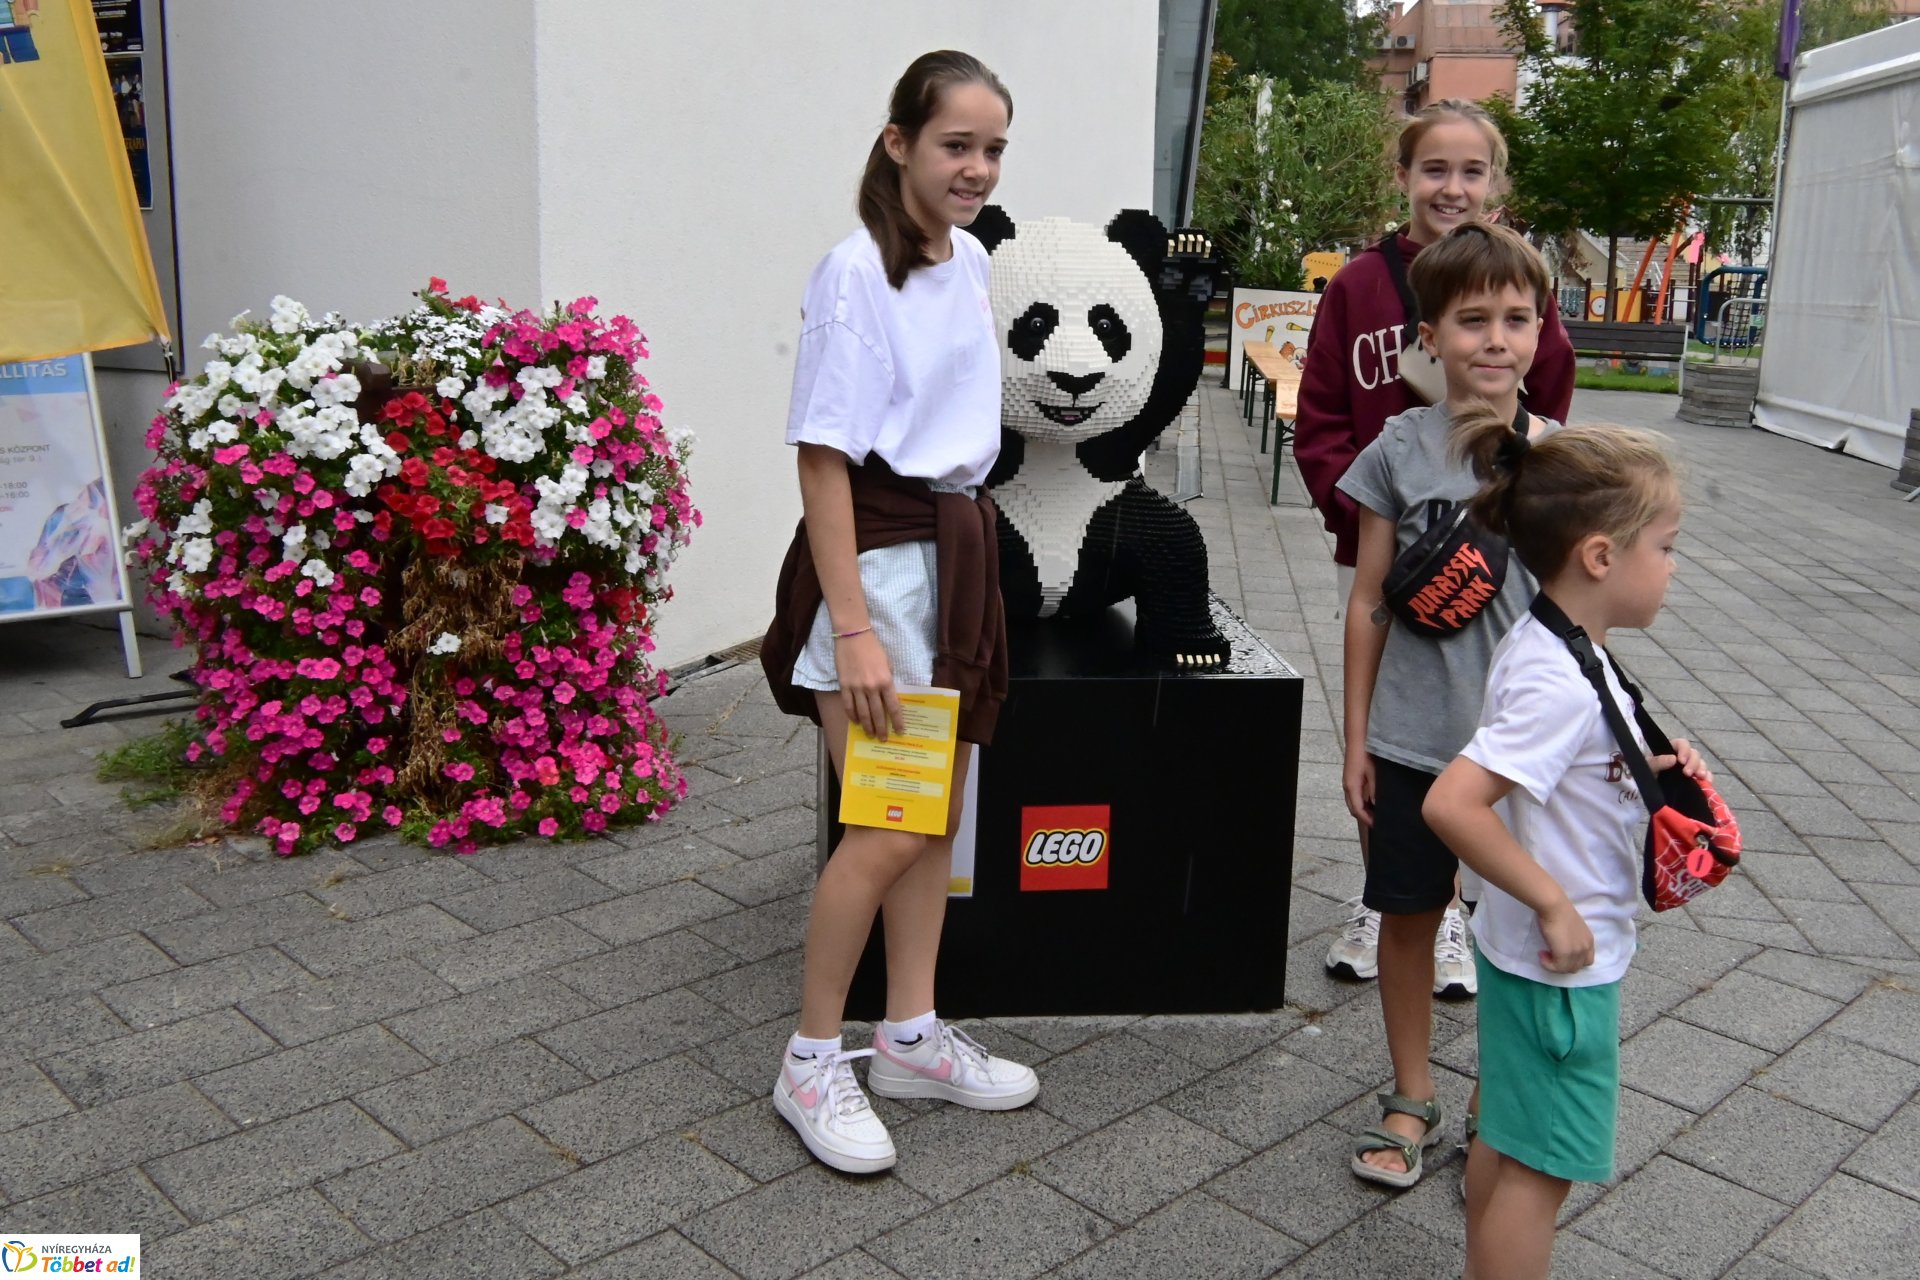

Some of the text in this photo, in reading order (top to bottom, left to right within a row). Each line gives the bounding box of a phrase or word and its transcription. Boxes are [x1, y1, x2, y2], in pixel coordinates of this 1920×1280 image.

[0, 360, 67, 379] LLÍTÁS
[1353, 323, 1409, 390] CH
[1408, 542, 1493, 630] JURASSIC
[1439, 574, 1497, 629] PARK
[887, 809, 903, 818] LEGO
[1024, 828, 1107, 867] LEGO
